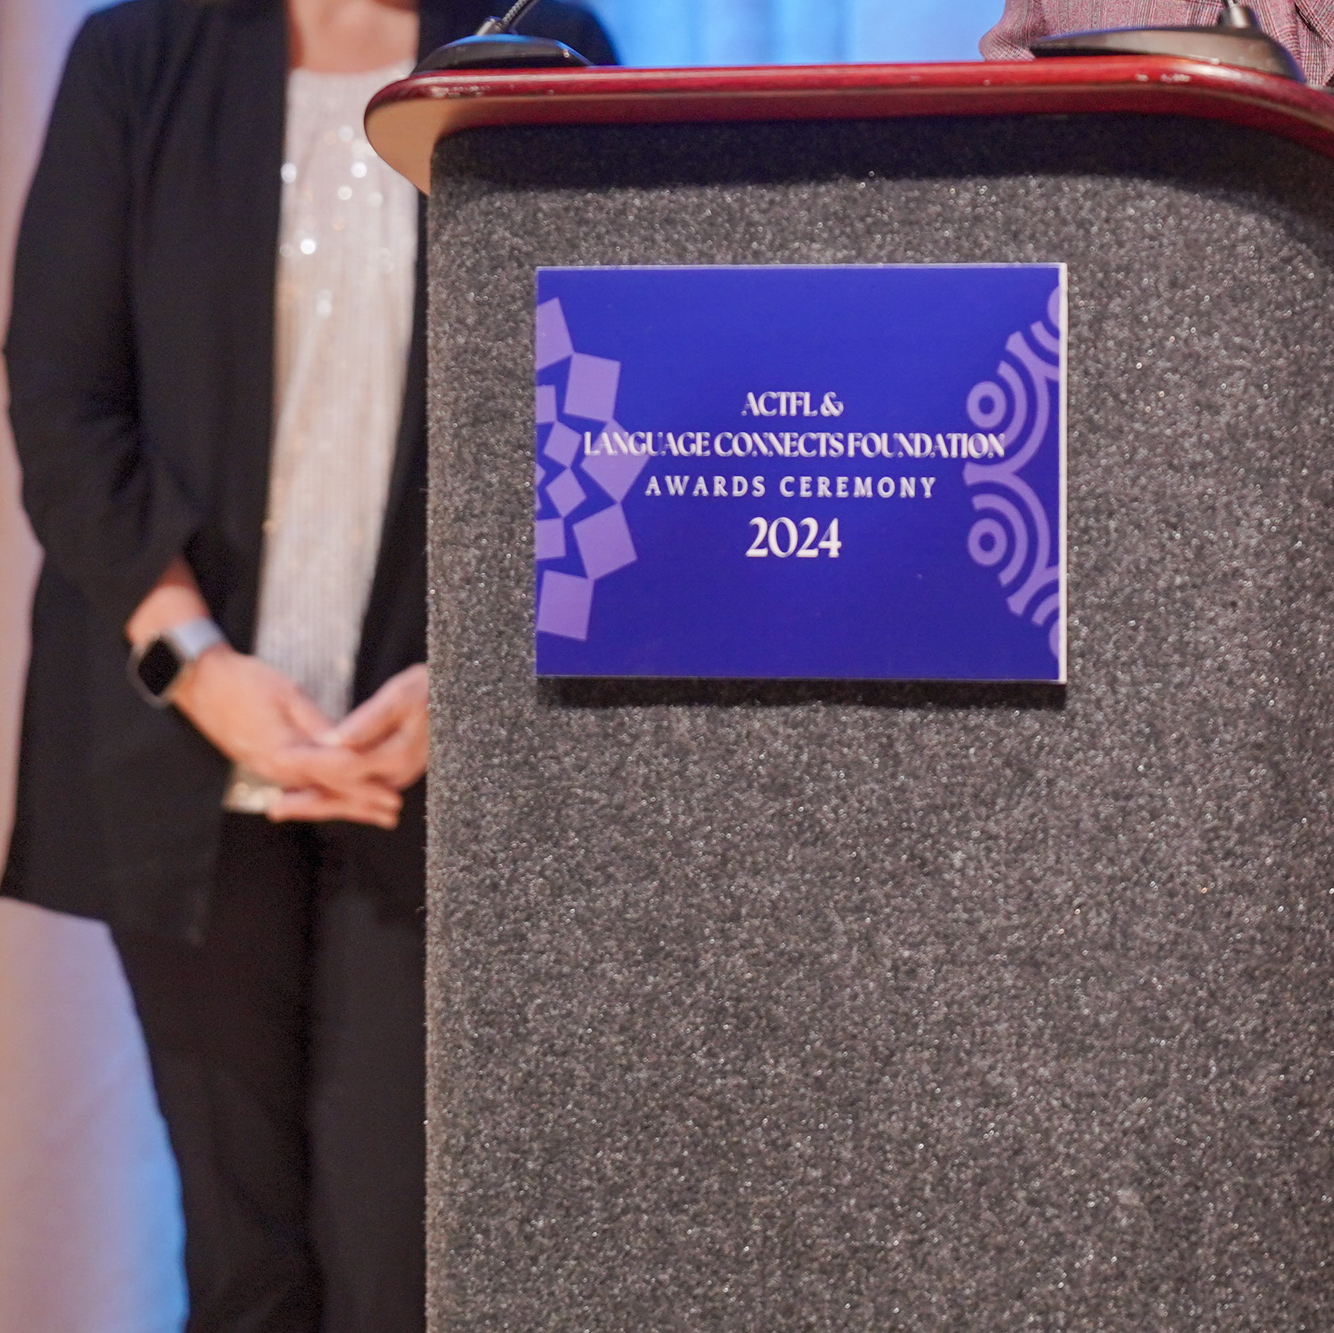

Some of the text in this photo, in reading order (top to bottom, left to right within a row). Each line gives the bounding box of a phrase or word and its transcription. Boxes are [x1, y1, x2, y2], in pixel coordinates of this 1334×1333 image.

[741, 391, 845, 417] ACTFL &
[583, 431, 1006, 459] LANGUAGE CONNECTS FOUNDATION
[645, 475, 937, 499] AWARDS CEREMONY
[745, 516, 842, 558] 2024
